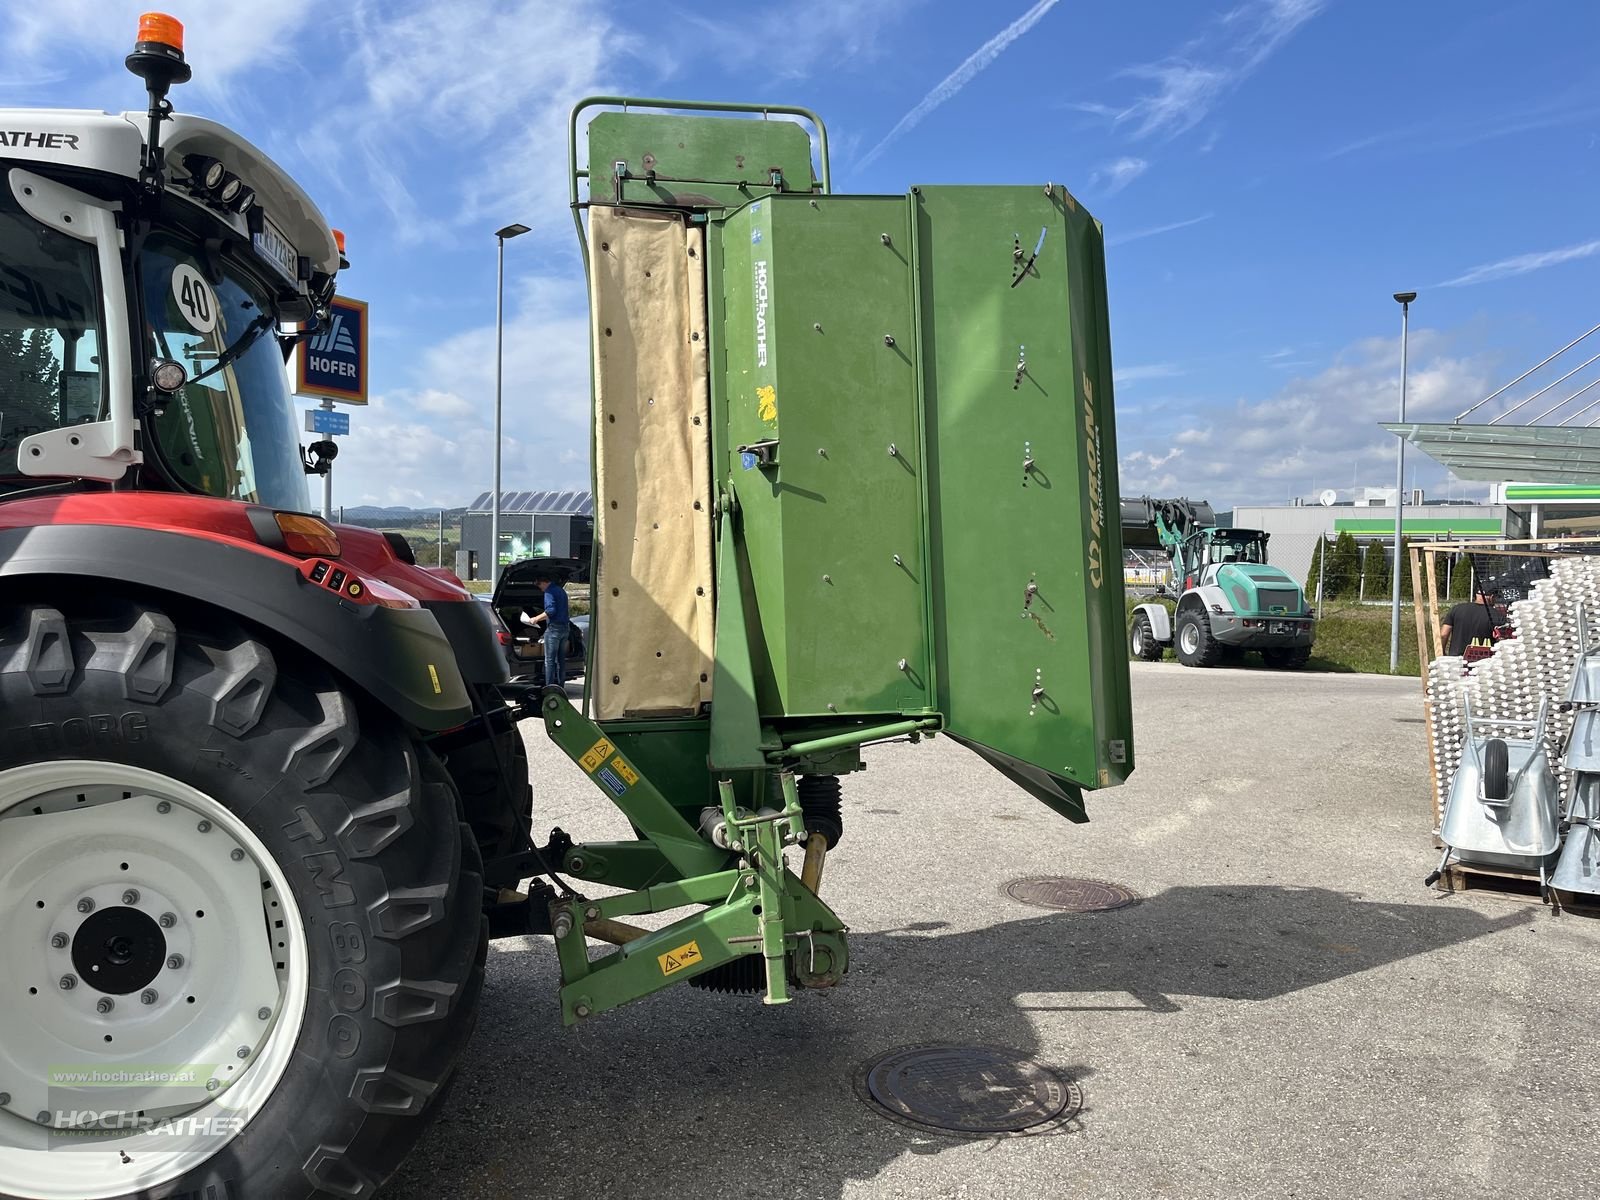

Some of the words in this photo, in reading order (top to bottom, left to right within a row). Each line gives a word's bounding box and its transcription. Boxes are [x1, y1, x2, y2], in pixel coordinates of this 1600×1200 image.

[180, 274, 212, 322] 40
[756, 261, 768, 367] HOCHRATHER
[309, 354, 357, 378] HOFER
[1082, 371, 1101, 539] KRONE
[326, 920, 369, 1060] 800
